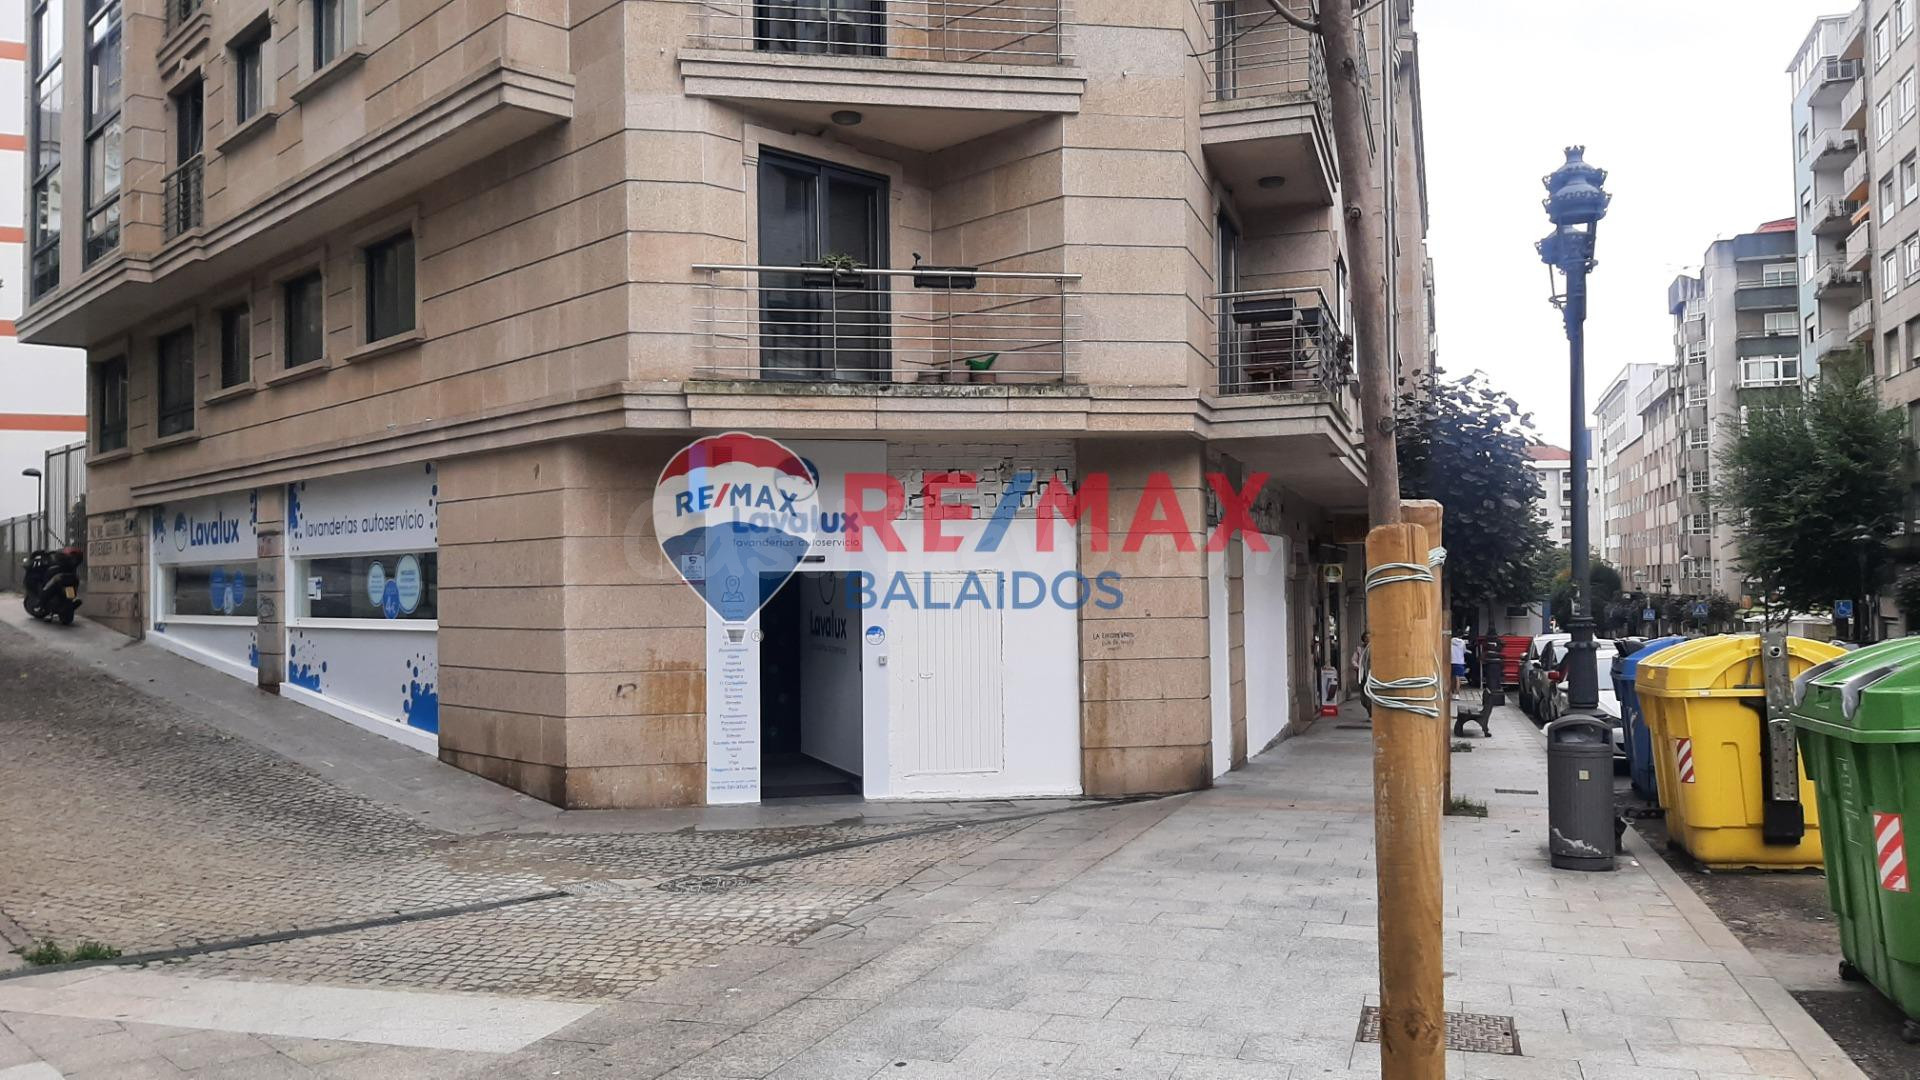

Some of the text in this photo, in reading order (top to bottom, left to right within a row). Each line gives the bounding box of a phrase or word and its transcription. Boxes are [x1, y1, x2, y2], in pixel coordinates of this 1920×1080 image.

[190, 510, 239, 546] Lavalux
[362, 509, 424, 533] autoservicio
[732, 504, 860, 533] Lavalux
[809, 608, 848, 640] Lavalux
